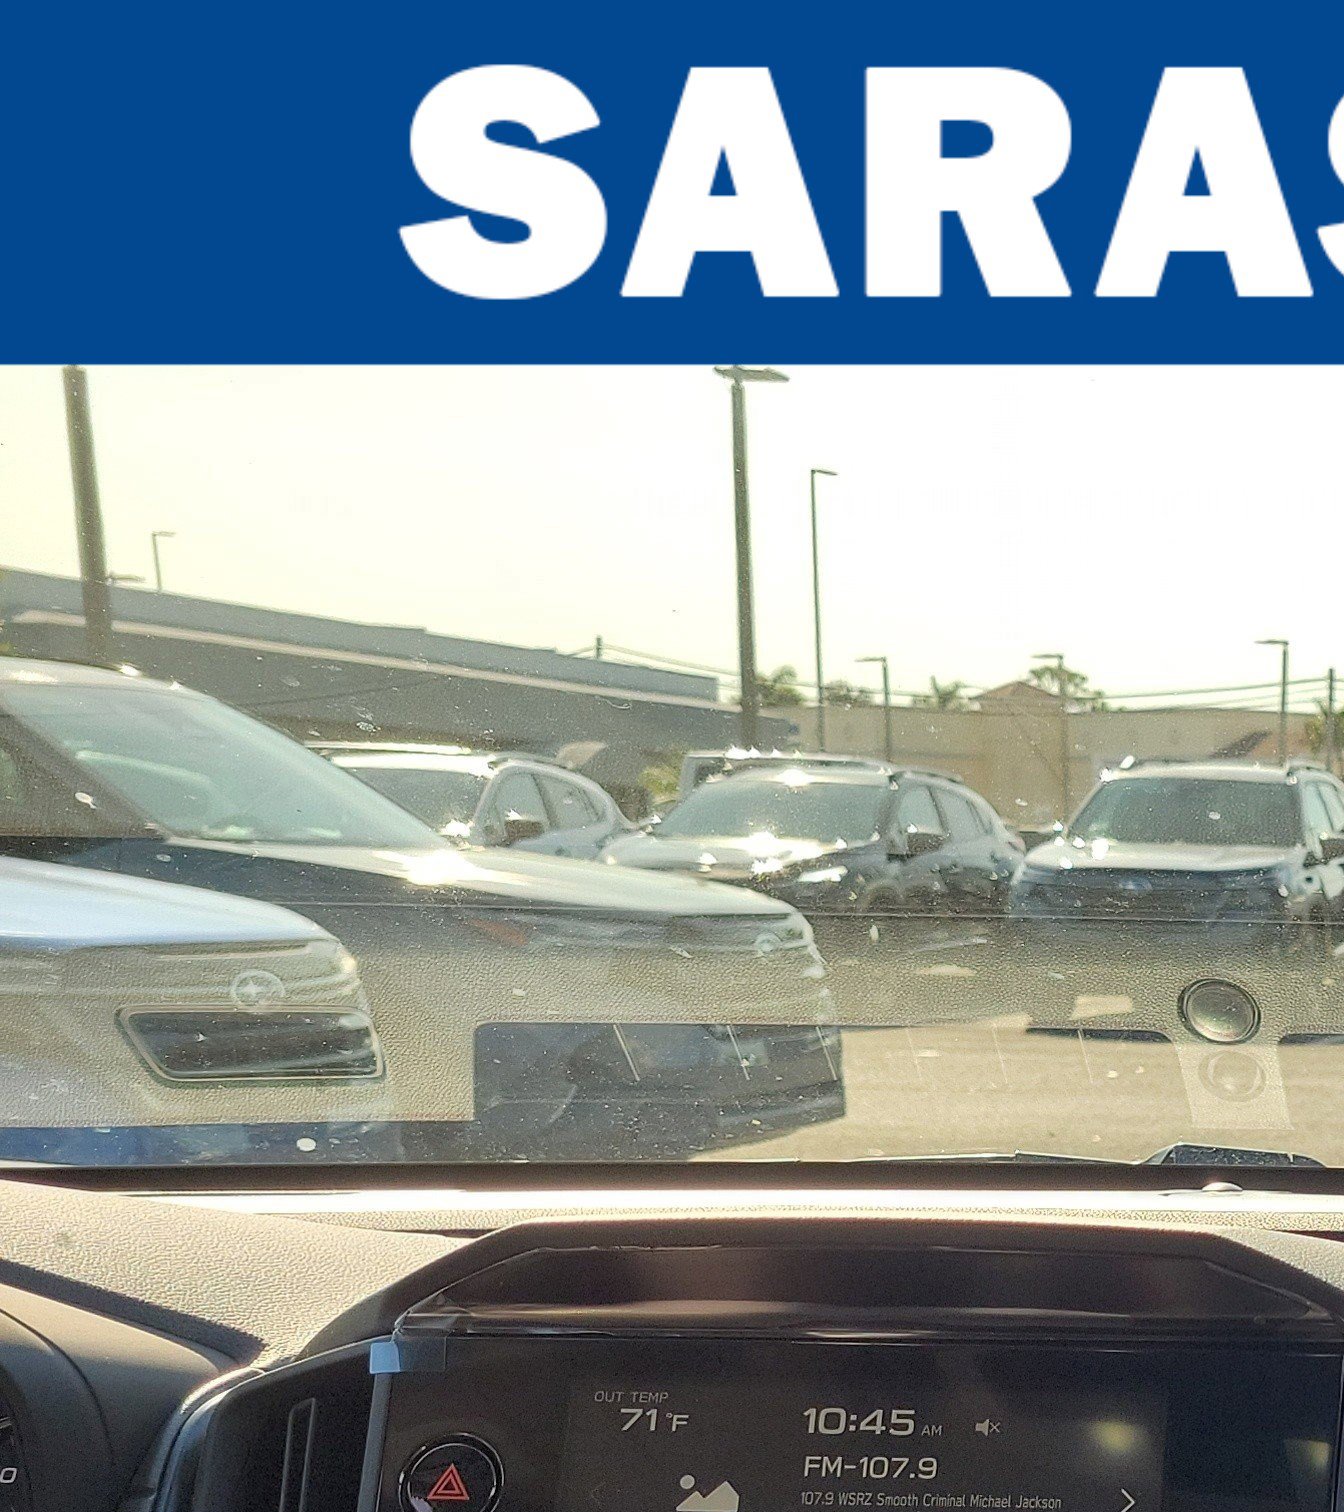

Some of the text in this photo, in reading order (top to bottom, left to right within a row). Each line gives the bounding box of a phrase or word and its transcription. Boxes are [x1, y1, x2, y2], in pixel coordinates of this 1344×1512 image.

[593, 1390, 668, 1403] OUT TEMP
[802, 1407, 942, 1436] 10:45 AM
[803, 1455, 937, 1479] FM-107.9
[800, 1490, 1061, 1509] 107.9 WSRZ Smooth Criminal Michael Jackson
